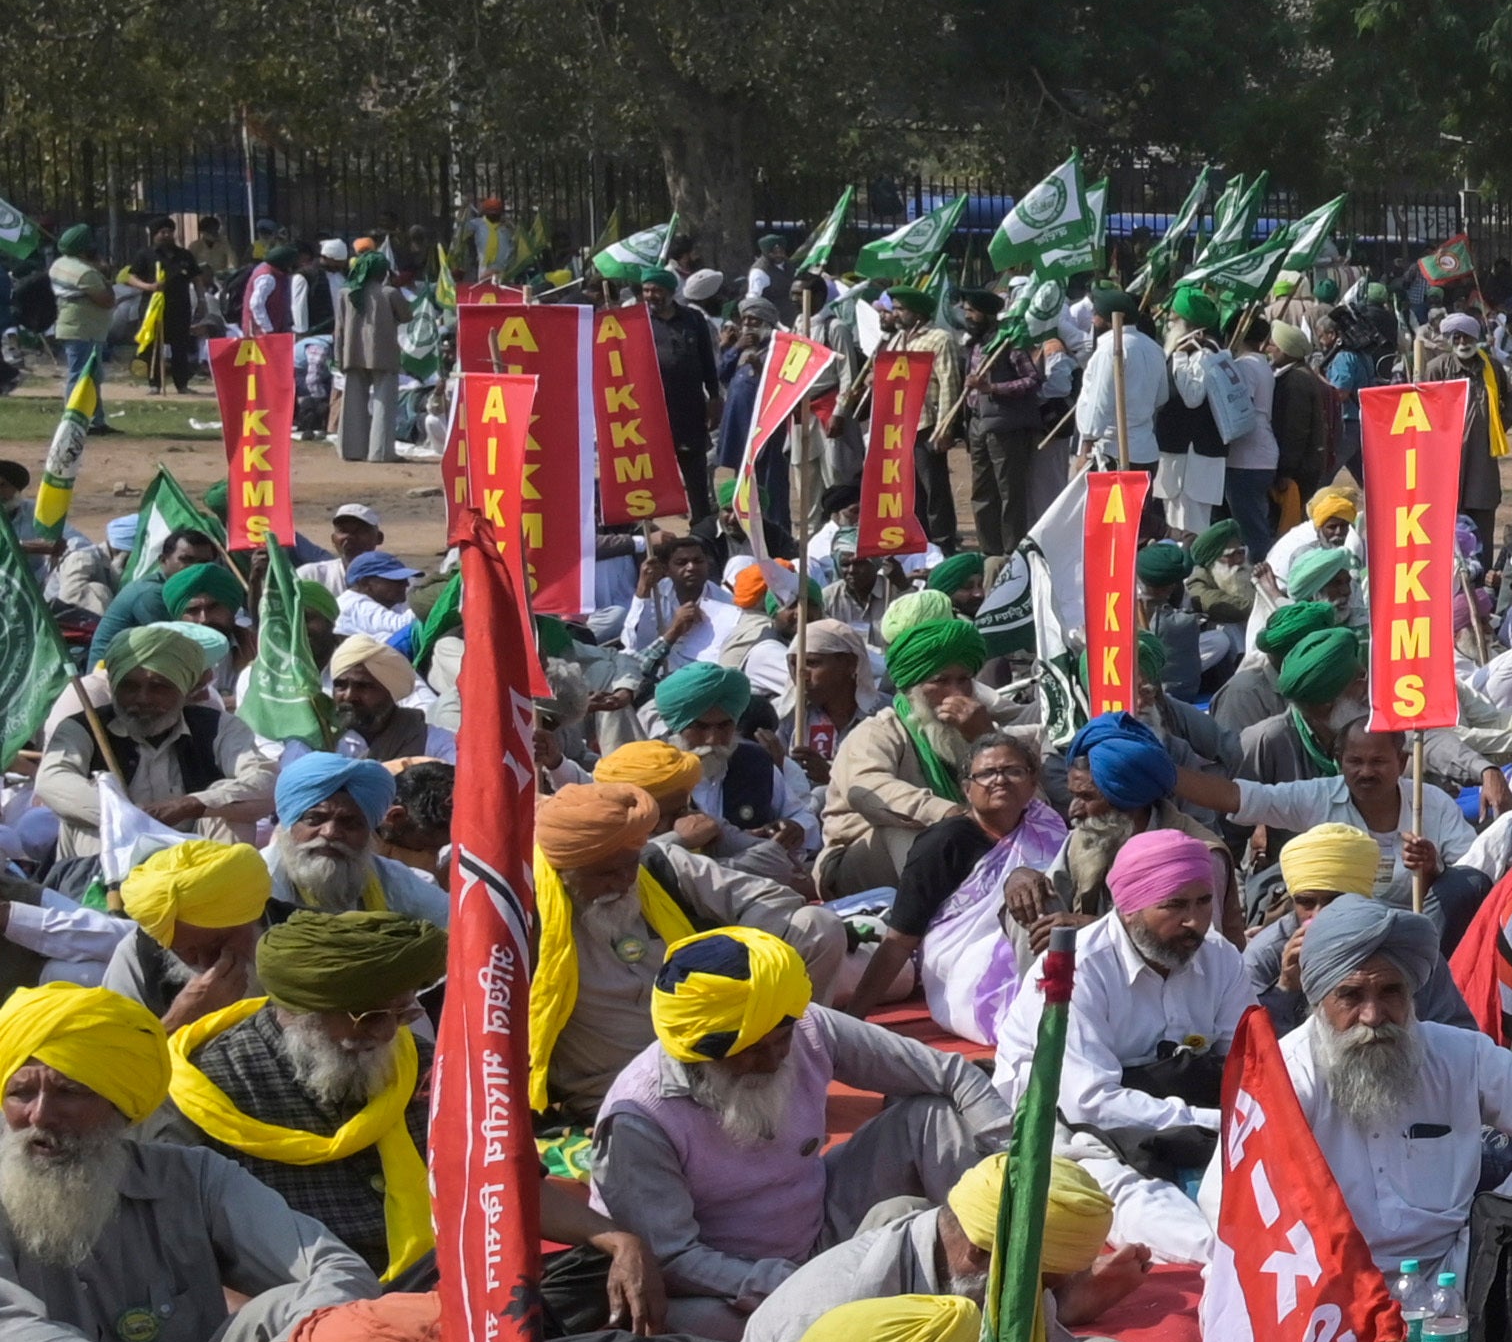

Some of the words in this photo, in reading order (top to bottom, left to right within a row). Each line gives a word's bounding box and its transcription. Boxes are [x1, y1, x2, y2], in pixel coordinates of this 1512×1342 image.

[233, 339, 275, 545] AIKKMS
[599, 315, 657, 517] AIKKMS
[875, 355, 910, 550] AIKKMS
[1390, 391, 1434, 718] AIKKMS
